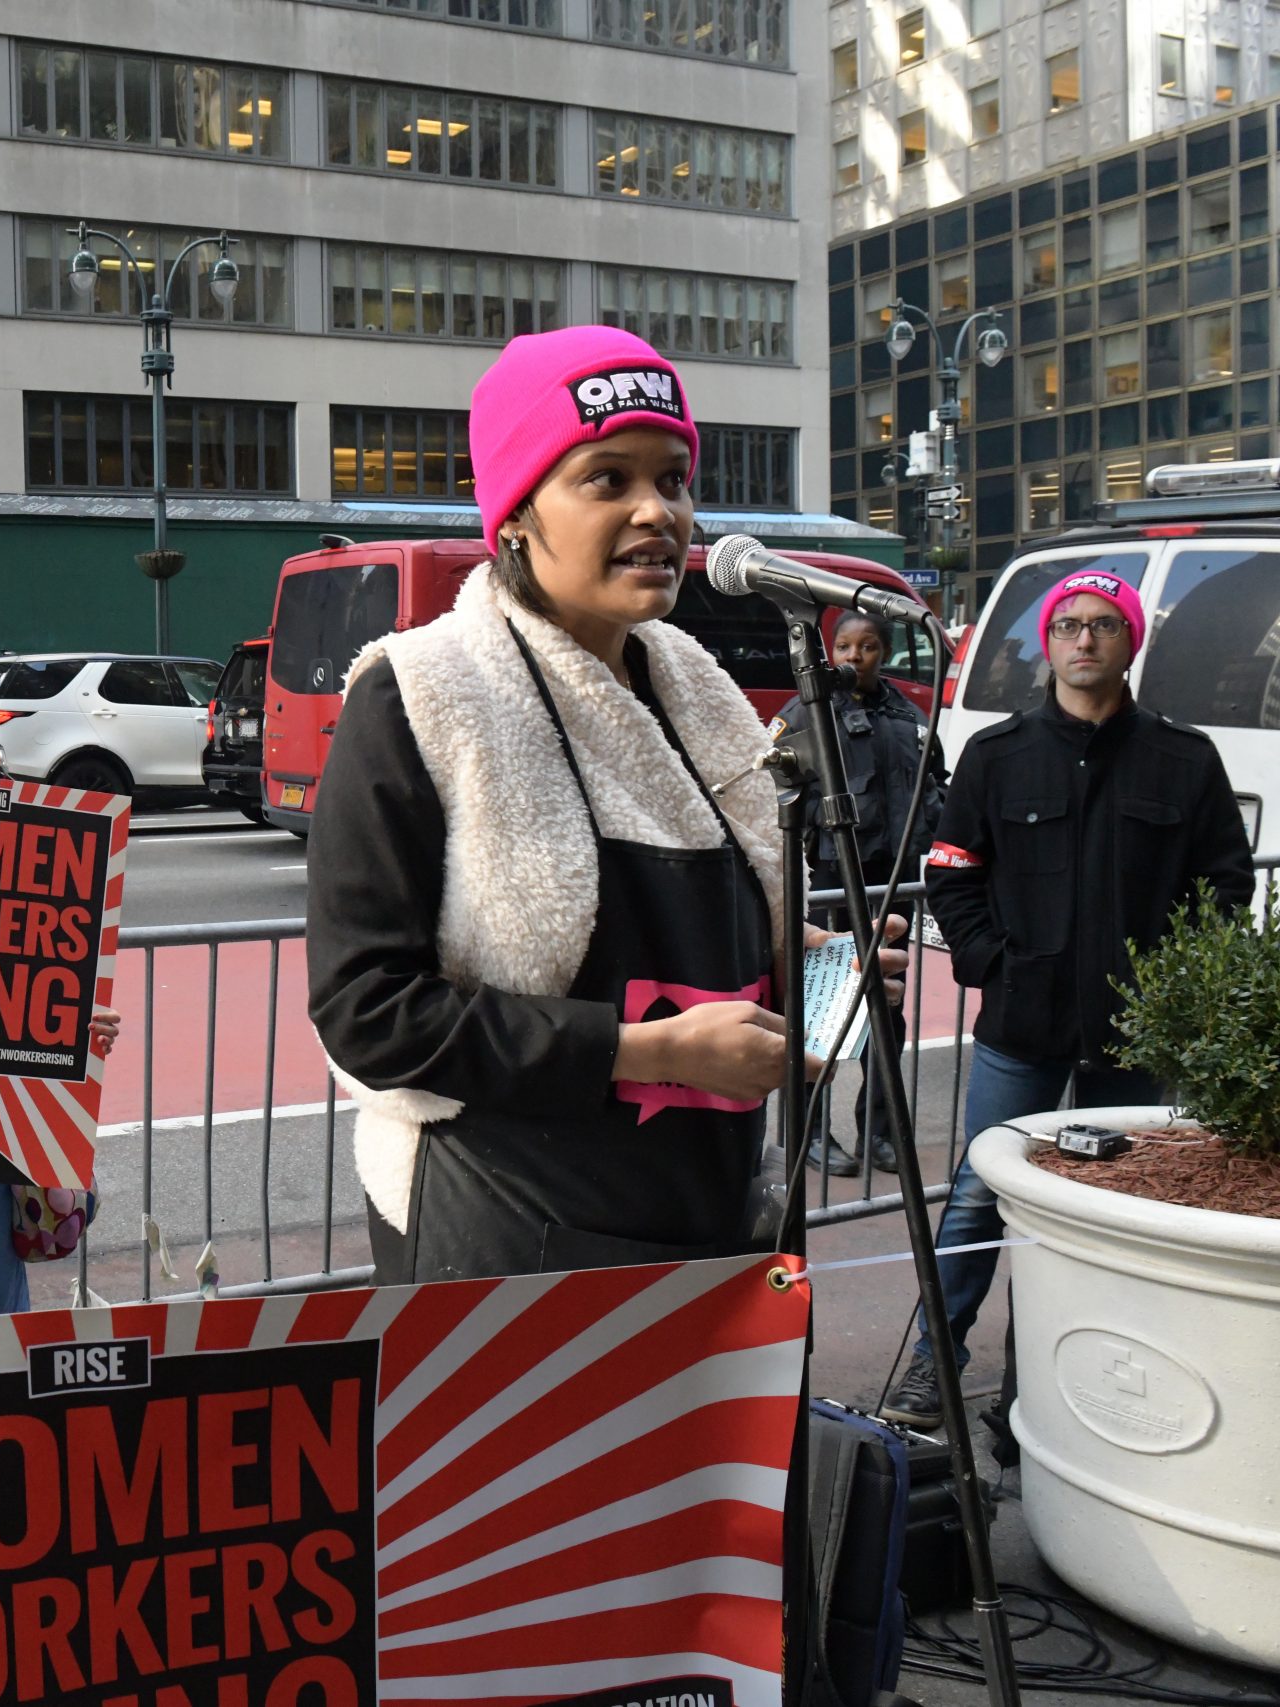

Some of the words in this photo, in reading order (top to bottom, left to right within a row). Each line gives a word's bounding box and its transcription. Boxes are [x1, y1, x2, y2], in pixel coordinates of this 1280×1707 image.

[577, 372, 672, 406] OFW
[585, 402, 614, 416] ONE
[618, 398, 646, 409] FAIR
[650, 399, 679, 413] WAGE
[53, 1344, 126, 1387] RISE
